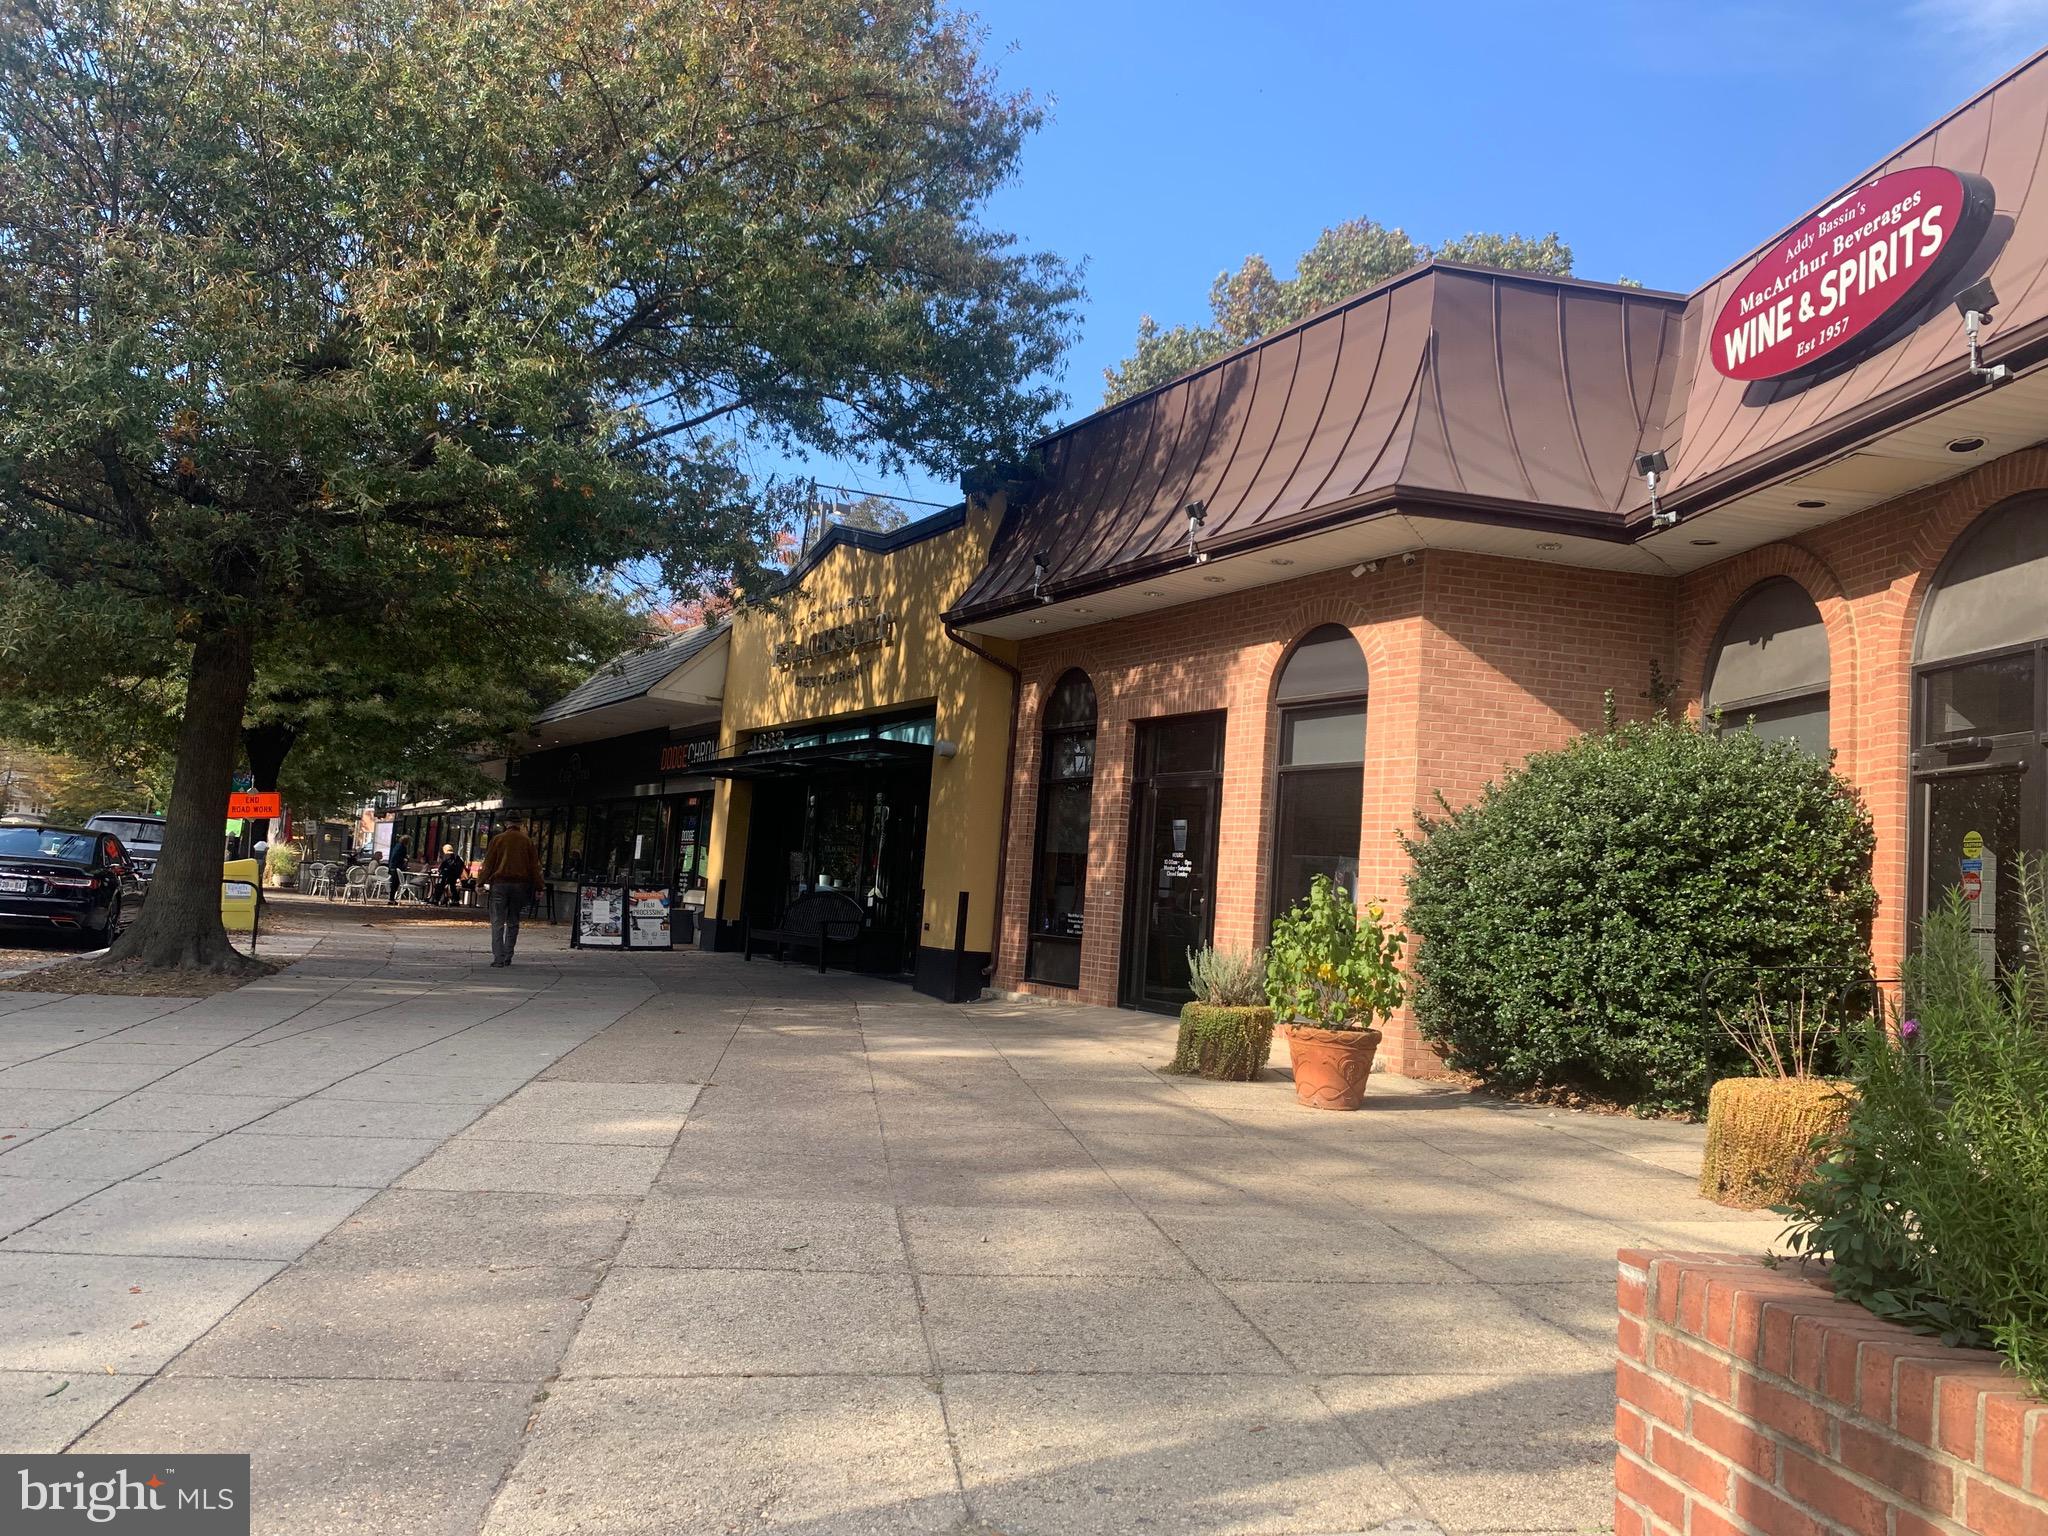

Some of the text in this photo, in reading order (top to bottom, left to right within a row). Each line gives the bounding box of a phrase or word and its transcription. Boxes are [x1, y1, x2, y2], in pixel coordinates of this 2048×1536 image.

[1784, 201, 1867, 264] Addy Bassin's
[1738, 190, 1922, 317] MacArthur Beverages
[1724, 204, 1943, 371] WINE & SPIRITS
[1796, 316, 1850, 359] Est 1957
[796, 659, 872, 688] RESTAURANT
[231, 805, 273, 813] ROAD WORK
[245, 796, 260, 804] END
[633, 908, 665, 916] PROCESSING
